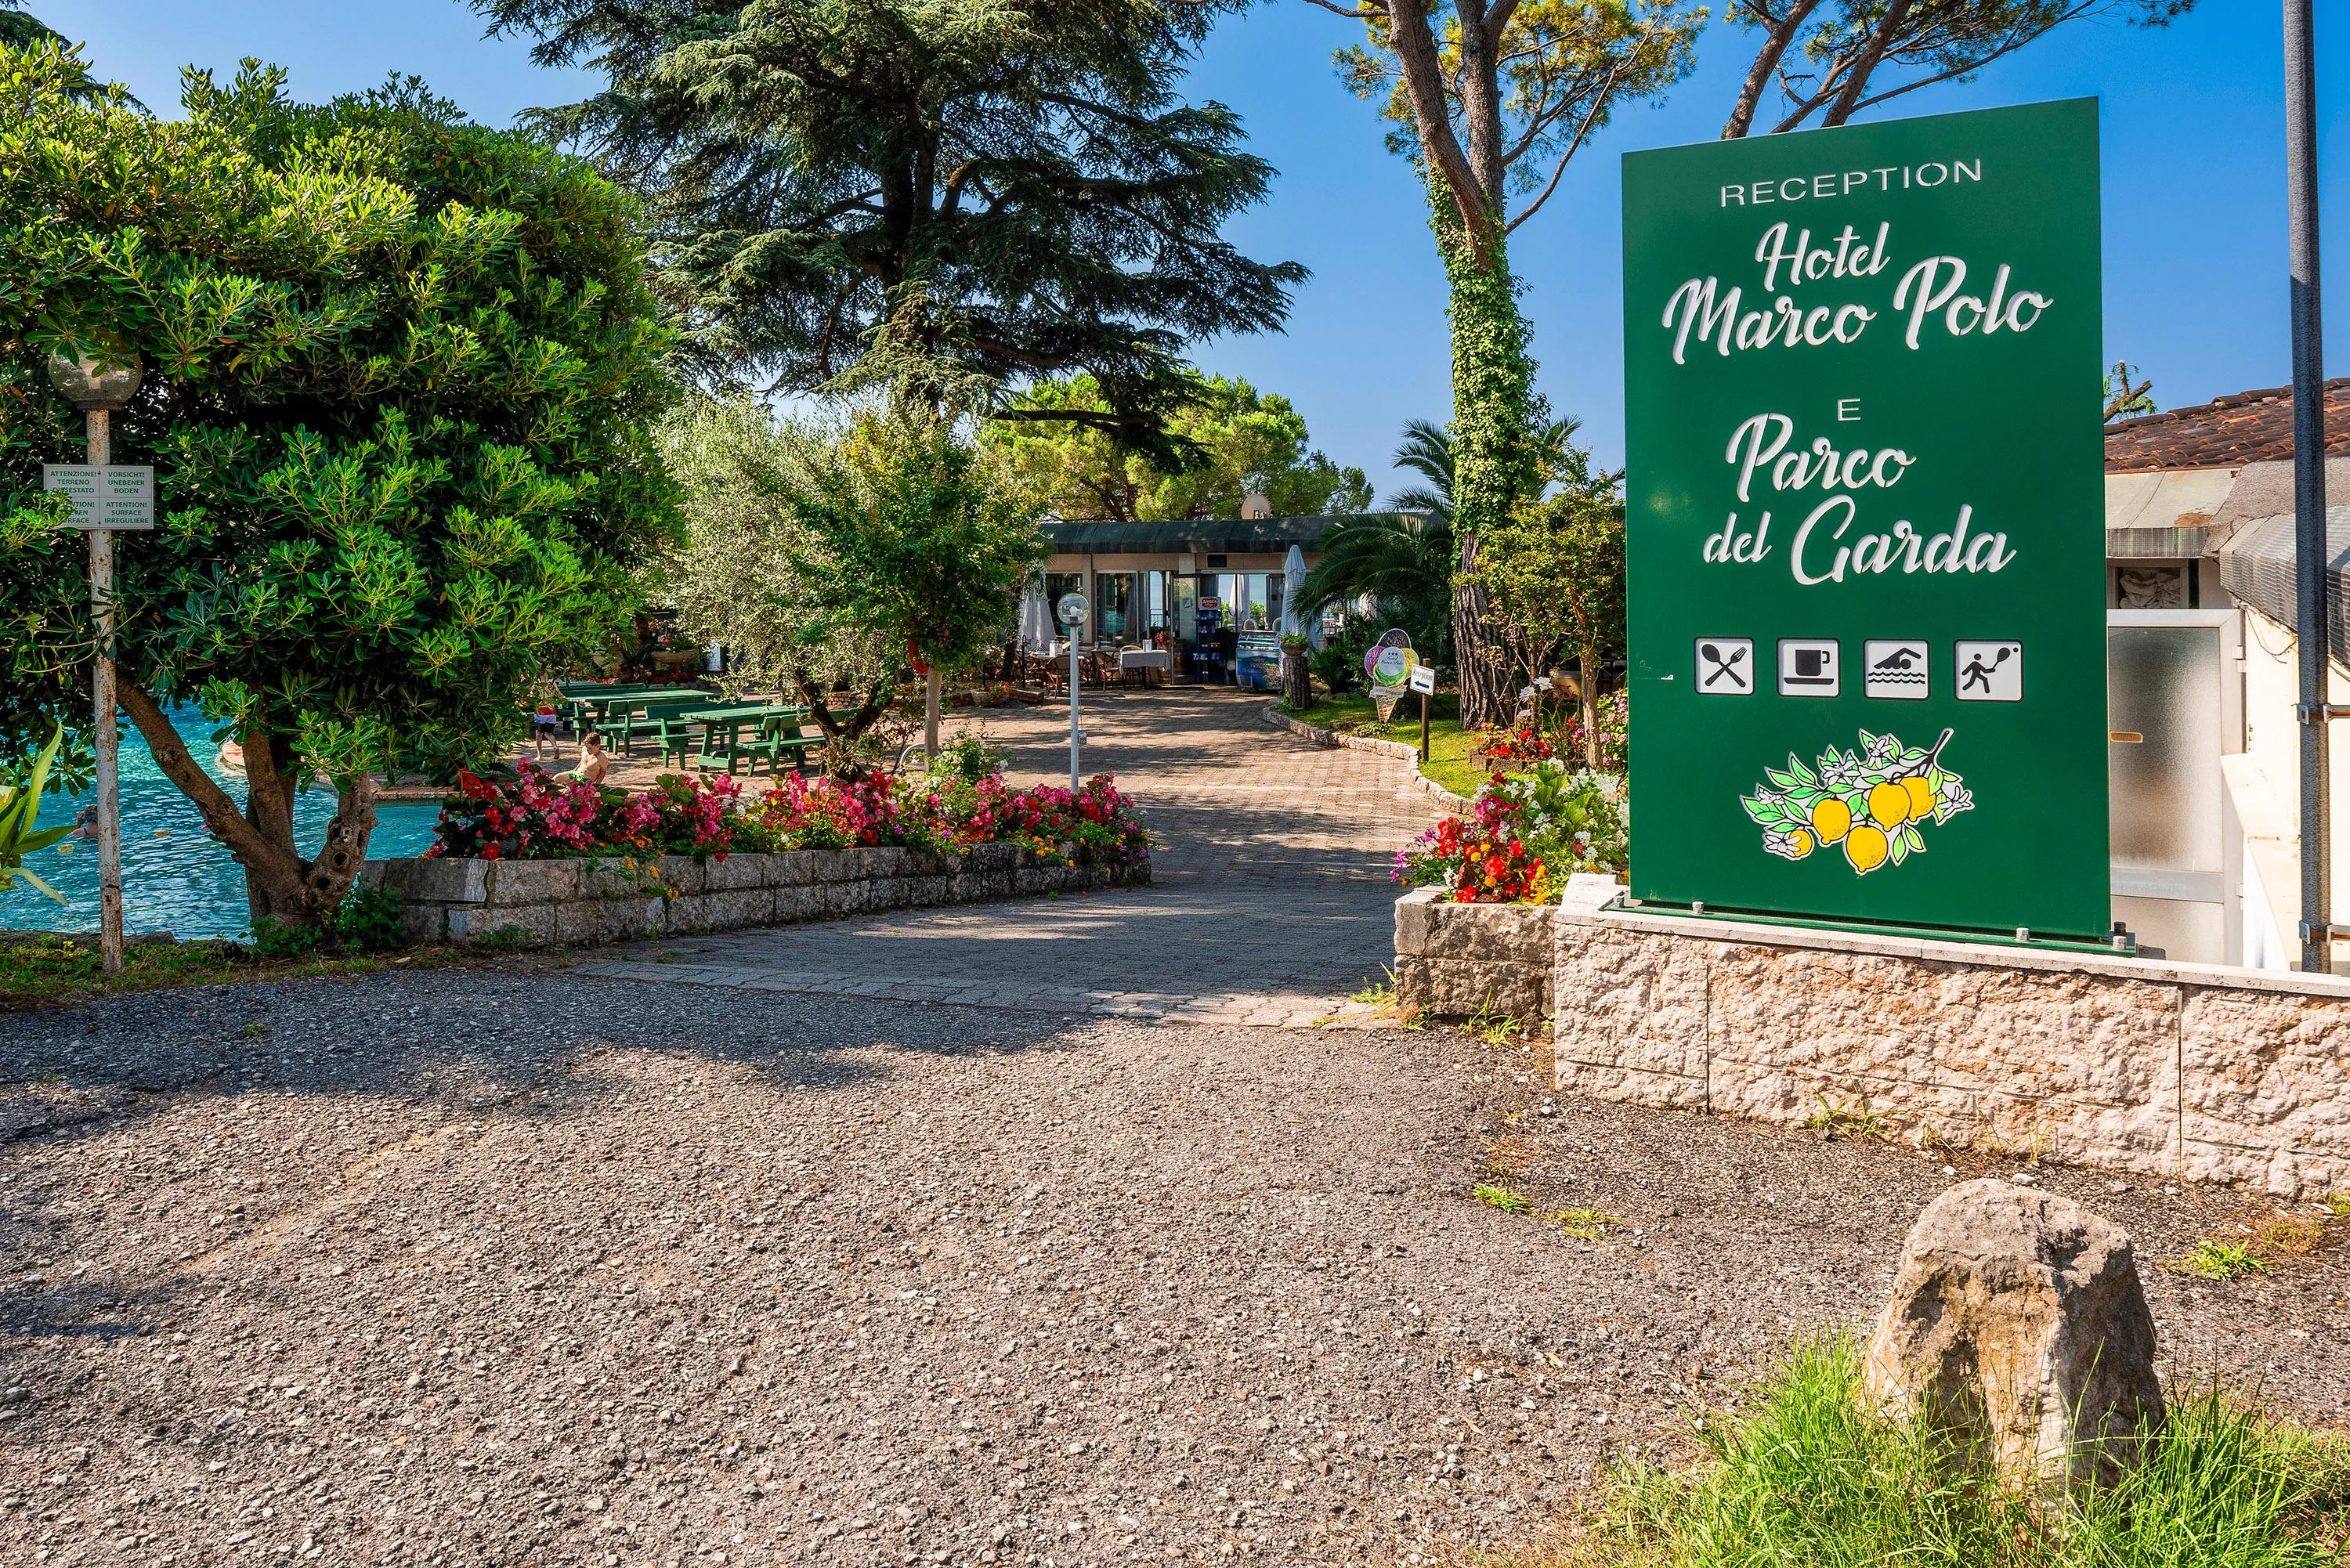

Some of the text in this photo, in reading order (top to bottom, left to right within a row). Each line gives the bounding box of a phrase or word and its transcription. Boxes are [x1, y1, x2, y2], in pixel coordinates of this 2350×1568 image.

[1720, 158, 1982, 208] RECEPTION
[1755, 222, 1891, 292] Hotel
[1661, 255, 2054, 365] Marco Polo
[1837, 398, 1861, 421] E
[1725, 413, 1917, 503] Parco
[1702, 494, 2017, 586] del Garda
